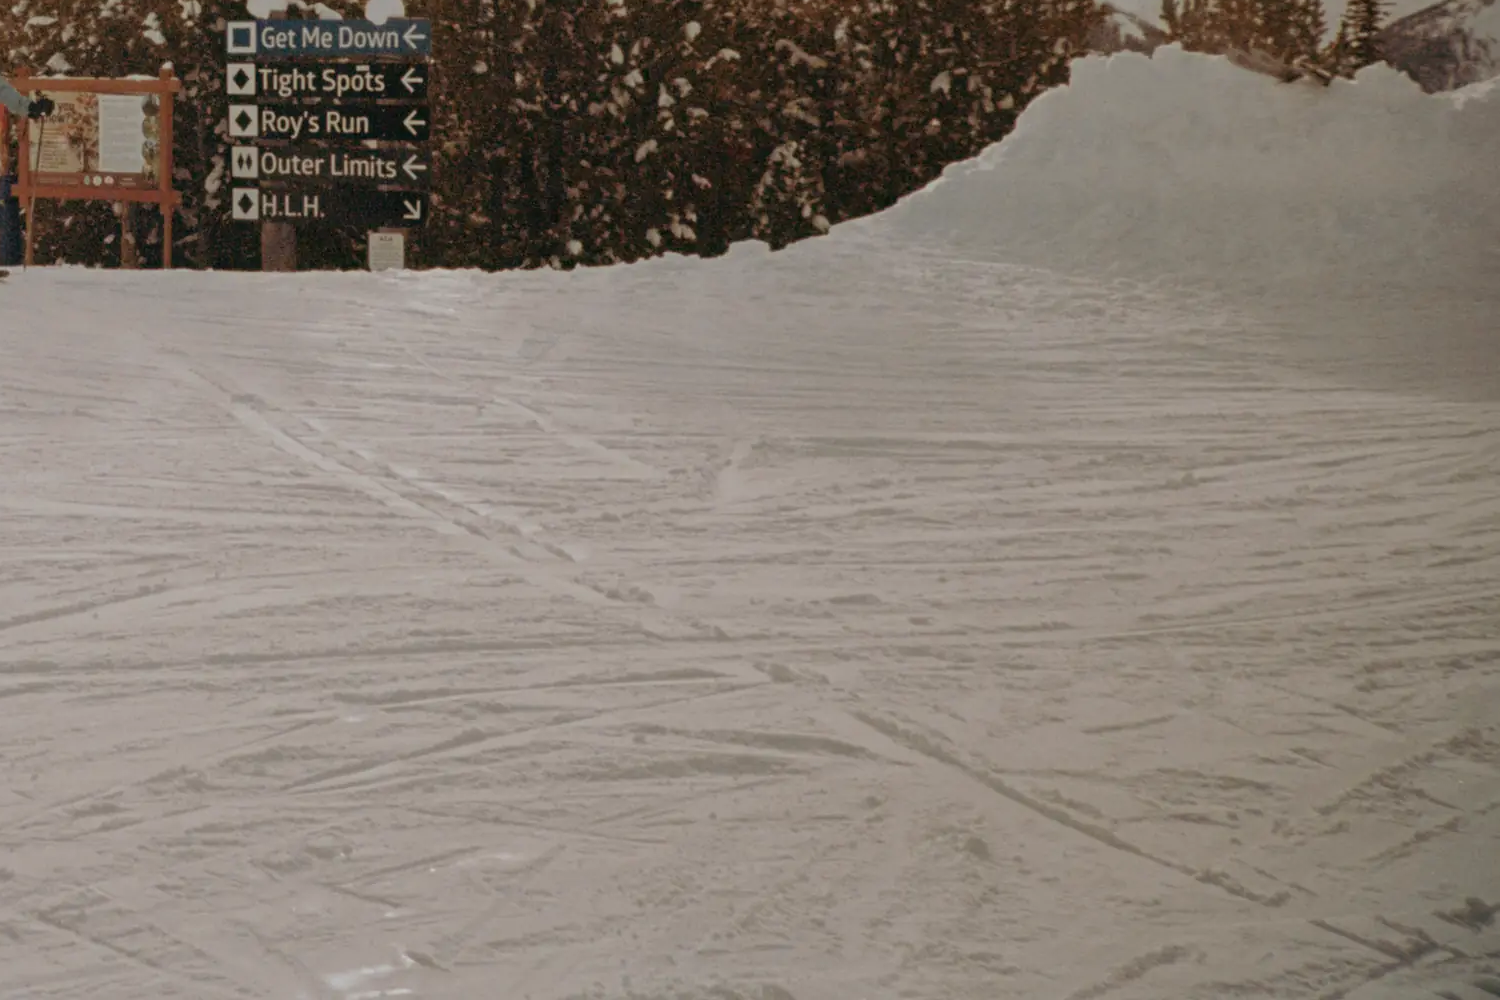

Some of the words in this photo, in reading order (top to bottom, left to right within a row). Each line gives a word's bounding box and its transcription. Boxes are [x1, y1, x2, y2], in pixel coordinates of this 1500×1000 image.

[261, 26, 296, 48] Get
[302, 27, 333, 48] Me
[338, 26, 399, 48] Down
[258, 68, 316, 97] Tight
[322, 69, 386, 97] Spots
[261, 110, 320, 139] Roy's
[326, 111, 369, 133] Run
[261, 152, 325, 177] Outer
[330, 153, 397, 179] Limits
[262, 195, 325, 218] H.L.H.
